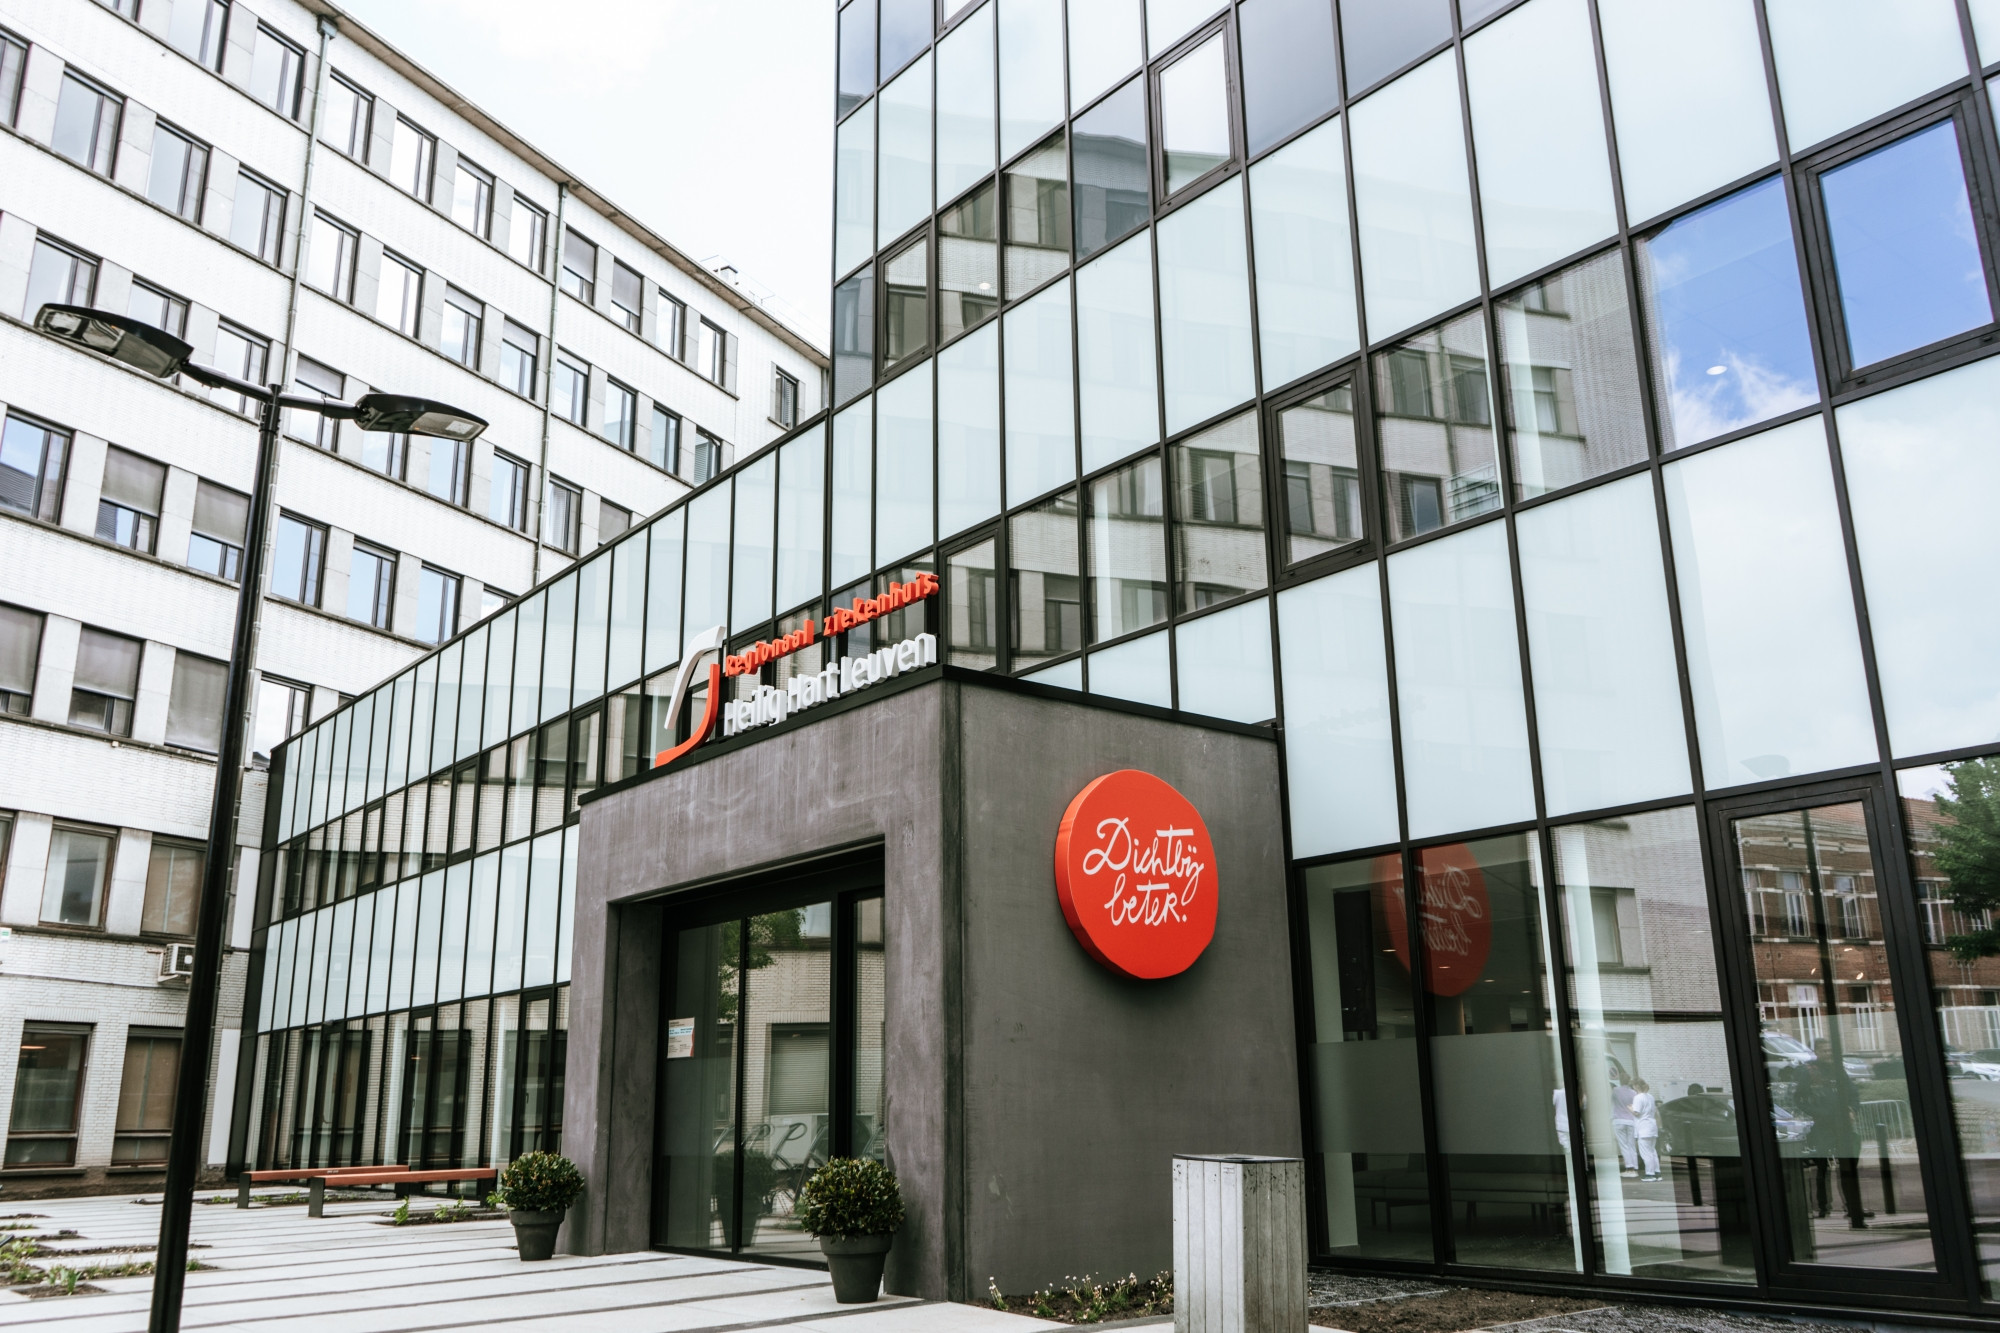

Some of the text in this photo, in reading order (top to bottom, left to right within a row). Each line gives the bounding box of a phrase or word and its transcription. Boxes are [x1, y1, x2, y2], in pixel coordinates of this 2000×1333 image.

[725, 571, 940, 677] Regionaal ziekenhuis
[723, 631, 938, 737] Heilig Hart Leuven
[1082, 817, 1205, 906] Dichtbij
